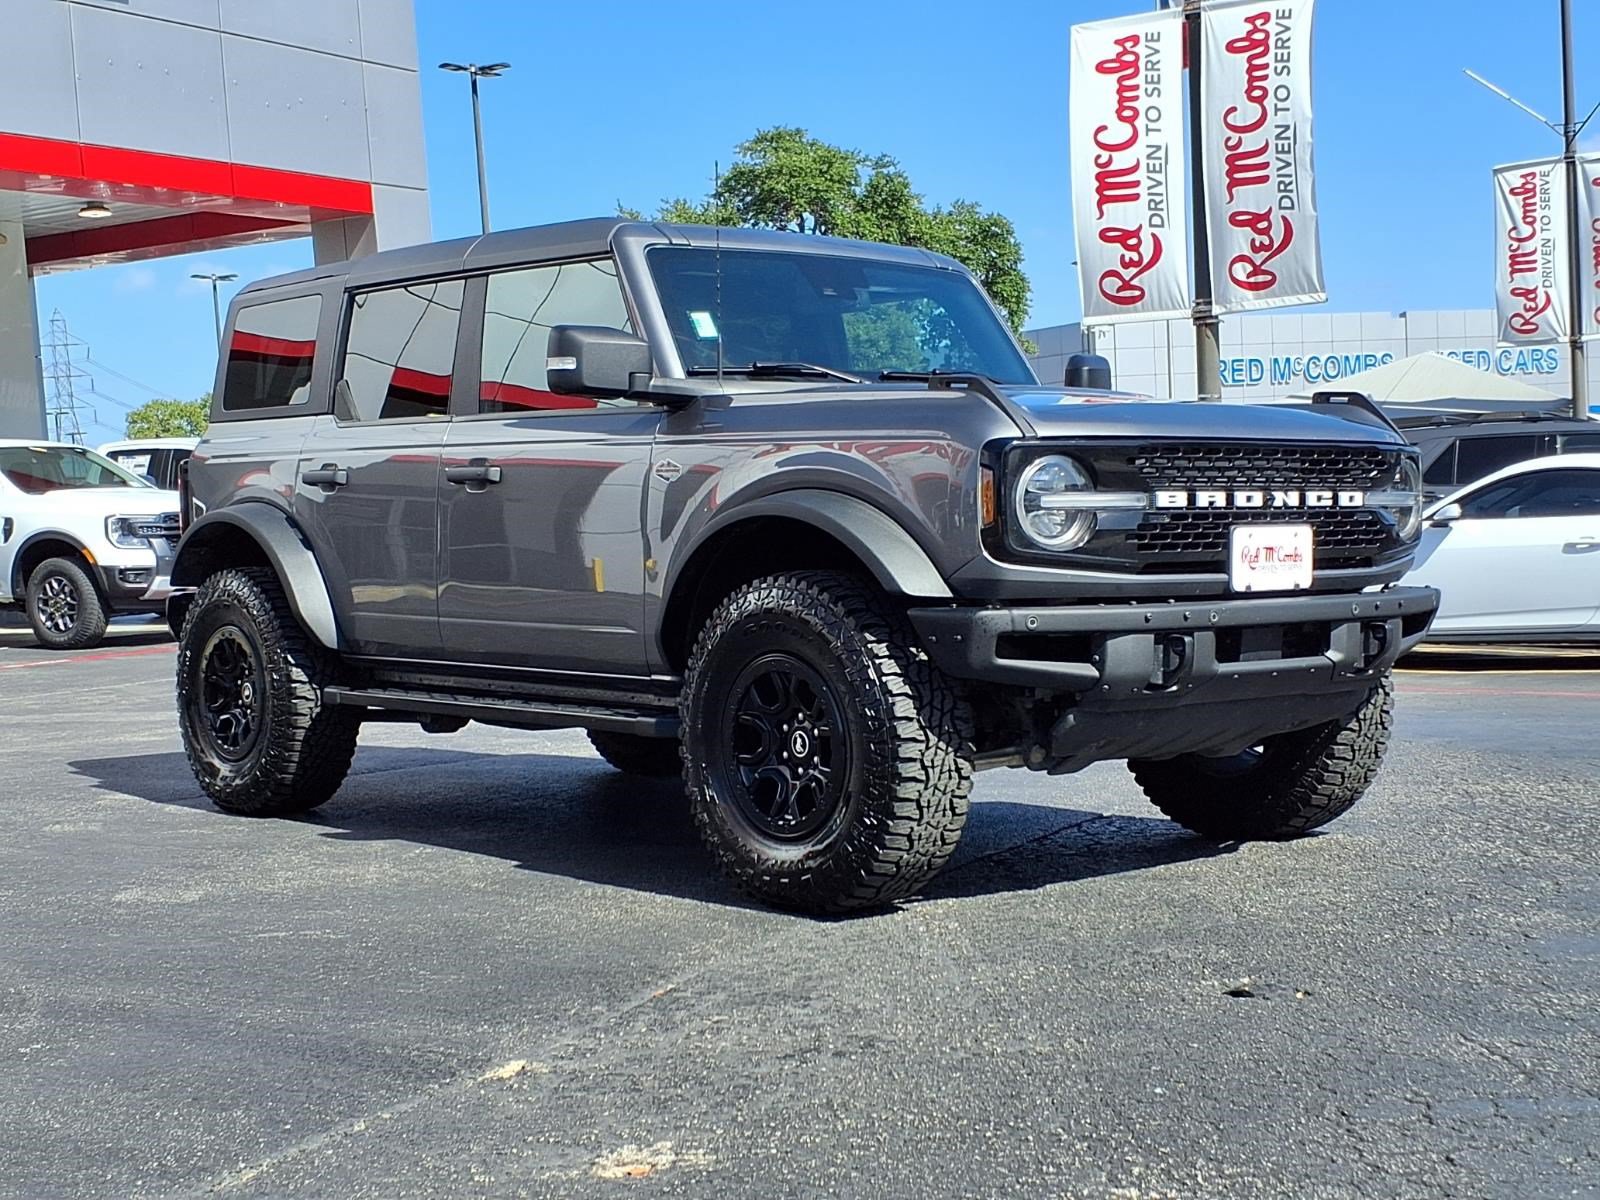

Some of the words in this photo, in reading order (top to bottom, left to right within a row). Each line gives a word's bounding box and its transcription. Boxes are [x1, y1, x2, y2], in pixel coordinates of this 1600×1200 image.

[1145, 31, 1161, 99] SERVE
[1274, 8, 1292, 77] SERVE
[1093, 33, 1142, 221] McCombs
[1145, 105, 1162, 137] TO
[1223, 11, 1272, 205] McCombs
[1273, 86, 1291, 117] TO
[1146, 144, 1165, 229] DRIVEN
[1274, 124, 1296, 211] DRIVEN
[1539, 169, 1551, 211] SERVE
[1228, 205, 1294, 292] Red
[1507, 171, 1538, 284] McCombs
[1540, 214, 1551, 235] TO
[1098, 224, 1163, 306] Red
[1540, 238, 1553, 289] DRIVEN
[1508, 284, 1552, 335] Red
[1219, 358, 1265, 384] RED
[1499, 348, 1559, 373] CARS
[1155, 490, 1364, 508] BRONCO
[1241, 545, 1260, 570] Red
